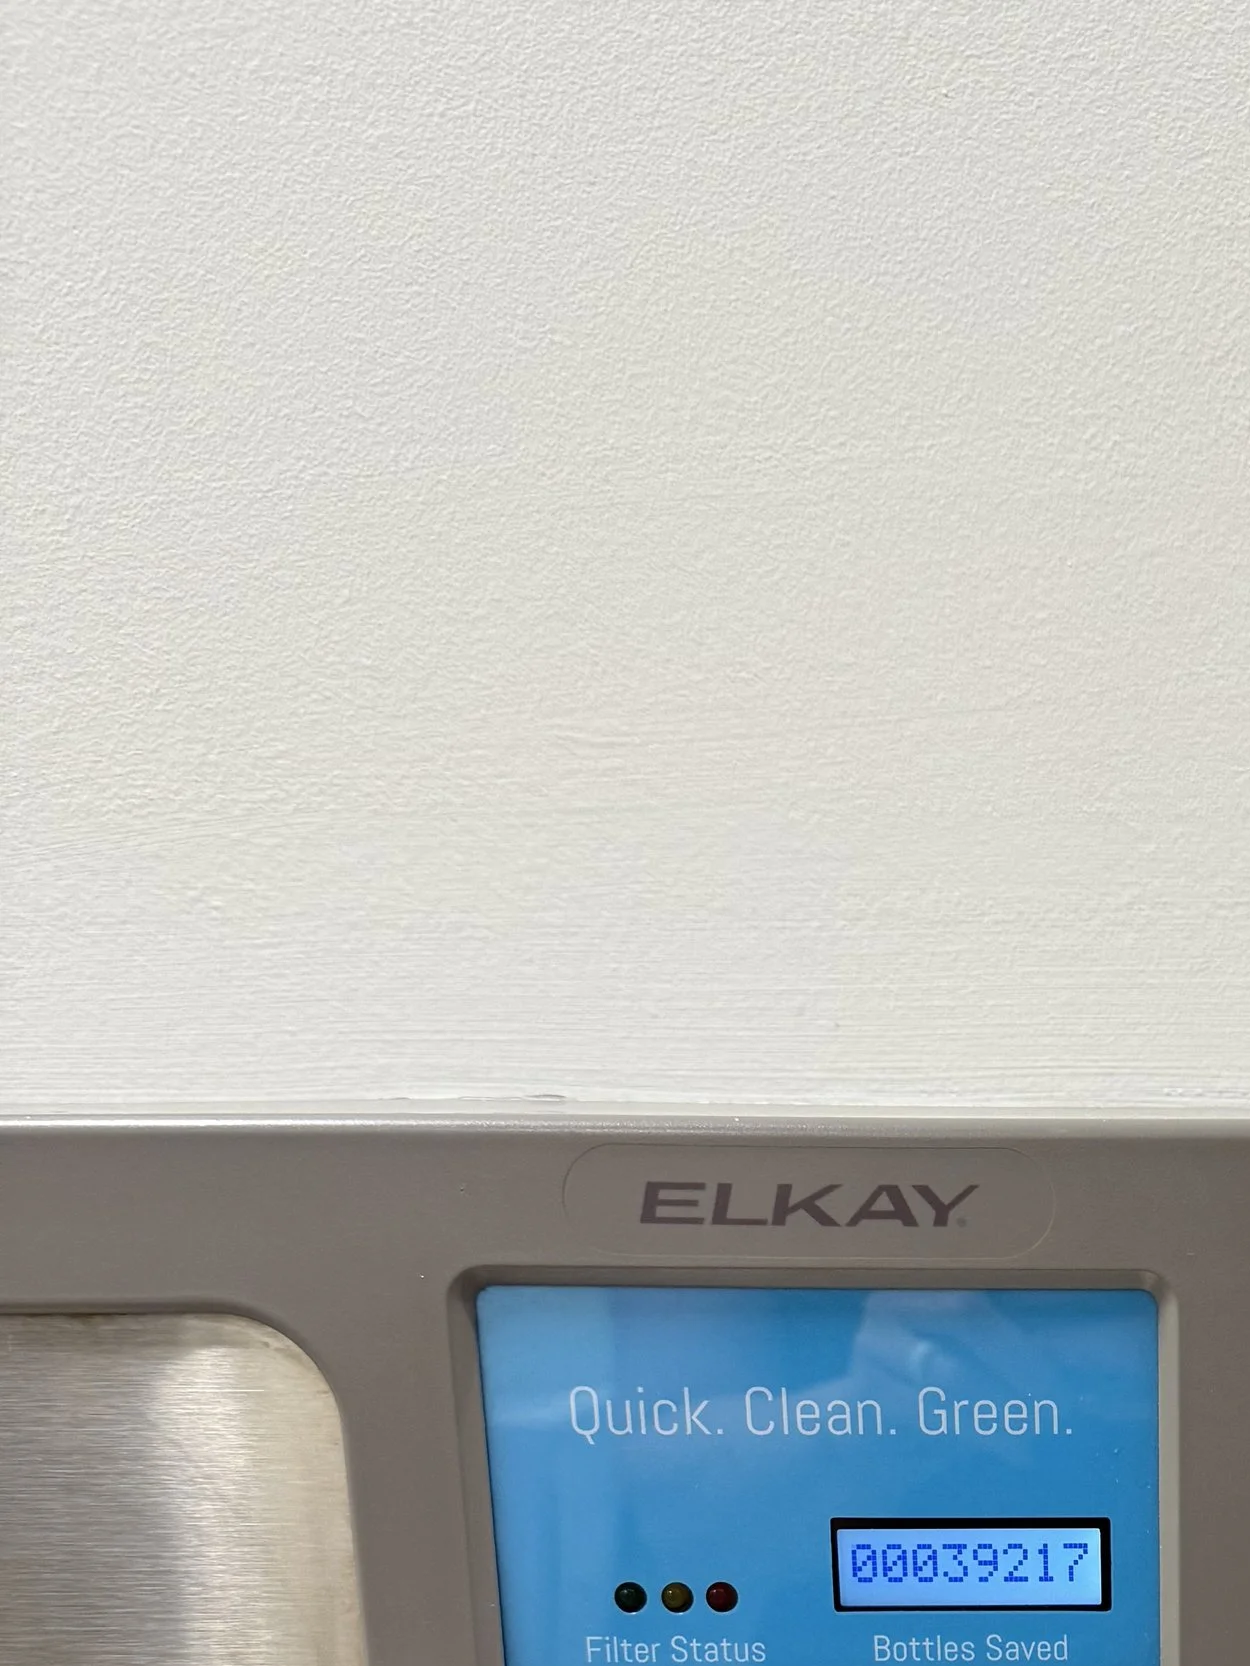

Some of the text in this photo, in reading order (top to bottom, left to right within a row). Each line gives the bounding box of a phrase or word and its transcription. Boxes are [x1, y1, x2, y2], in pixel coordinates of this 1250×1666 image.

[639, 1180, 980, 1227] ELKAY
[568, 1385, 1074, 1445] Quick. Clean. Green.
[850, 1543, 1089, 1583] 00039217
[585, 1635, 767, 1664] Filter Status
[873, 1634, 1069, 1663] Bottles Saved
